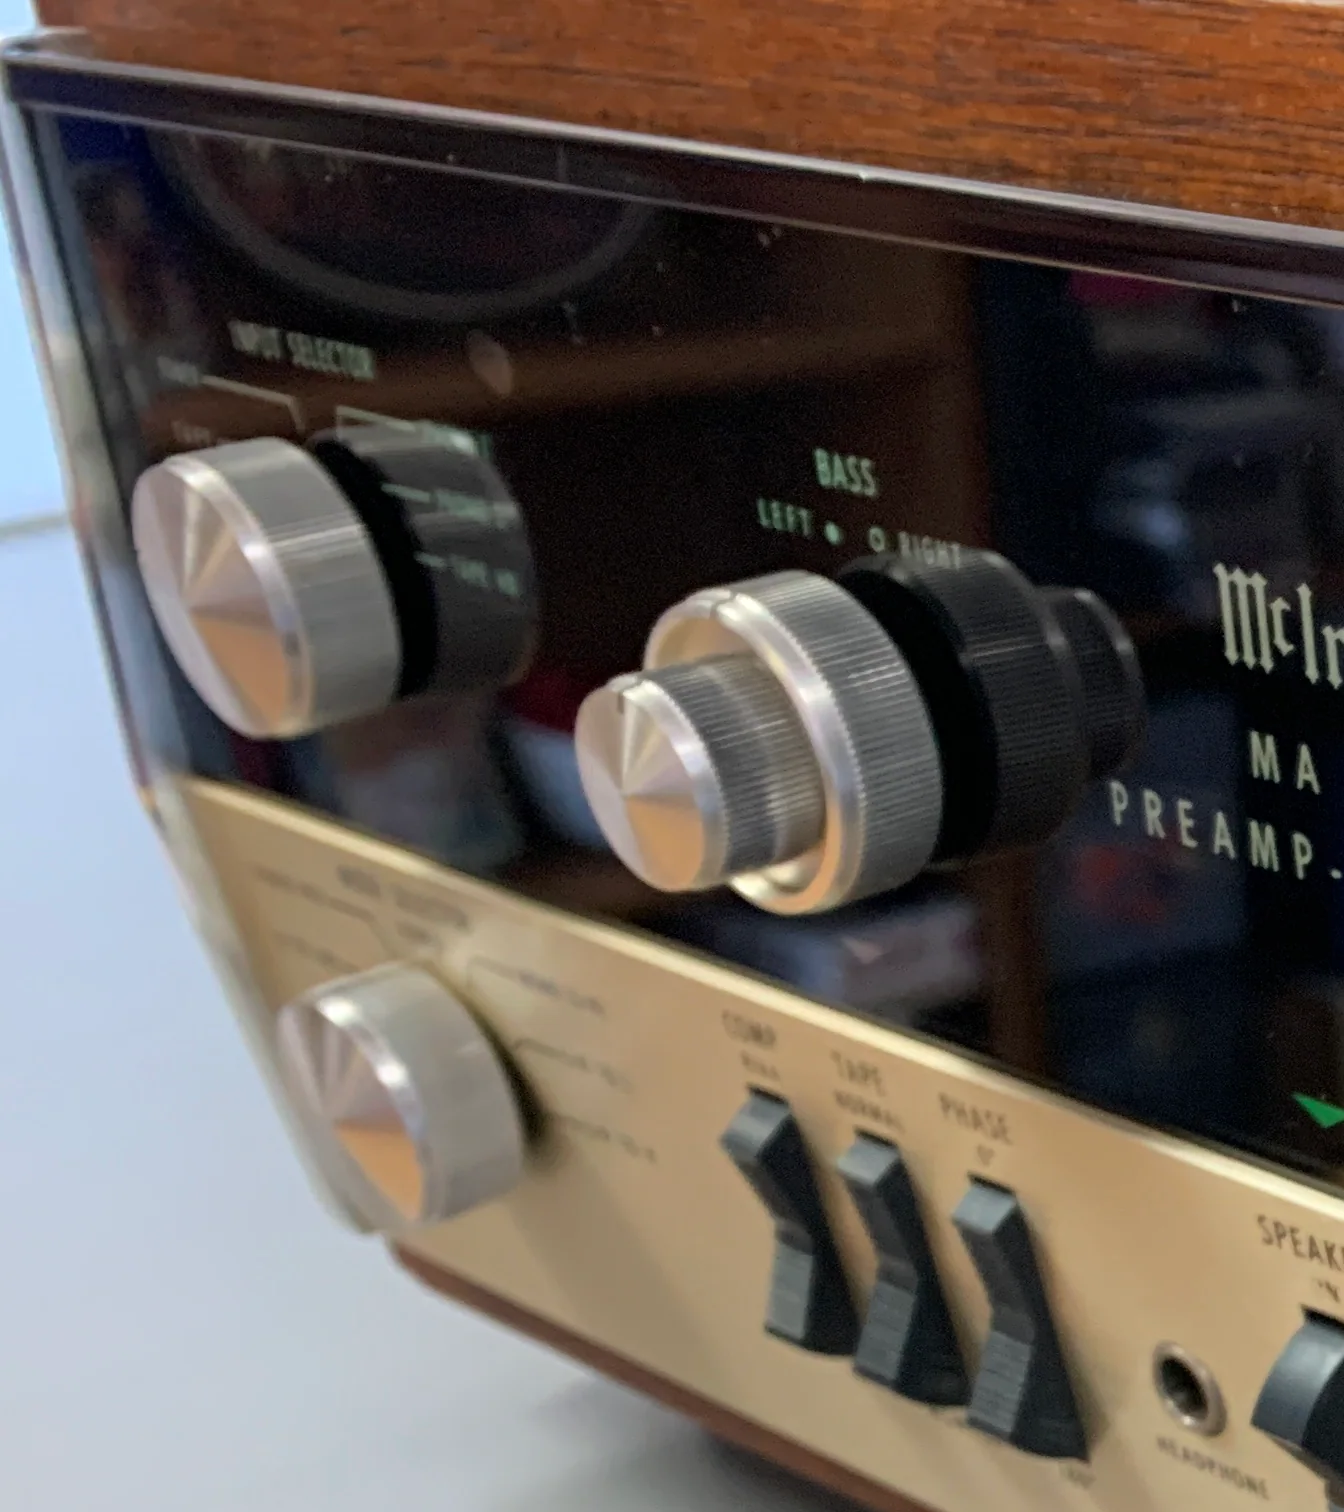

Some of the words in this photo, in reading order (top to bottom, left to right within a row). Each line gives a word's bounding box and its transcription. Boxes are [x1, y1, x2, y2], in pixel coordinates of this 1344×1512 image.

[814, 447, 878, 497] BASS
[757, 497, 814, 538] LEFT
[898, 531, 961, 571] RIGHT
[1248, 729, 1321, 795] MA
[829, 1050, 888, 1097] TAPE
[938, 1091, 1014, 1146] PHASE
[1156, 1434, 1270, 1500] HEADPHONE
